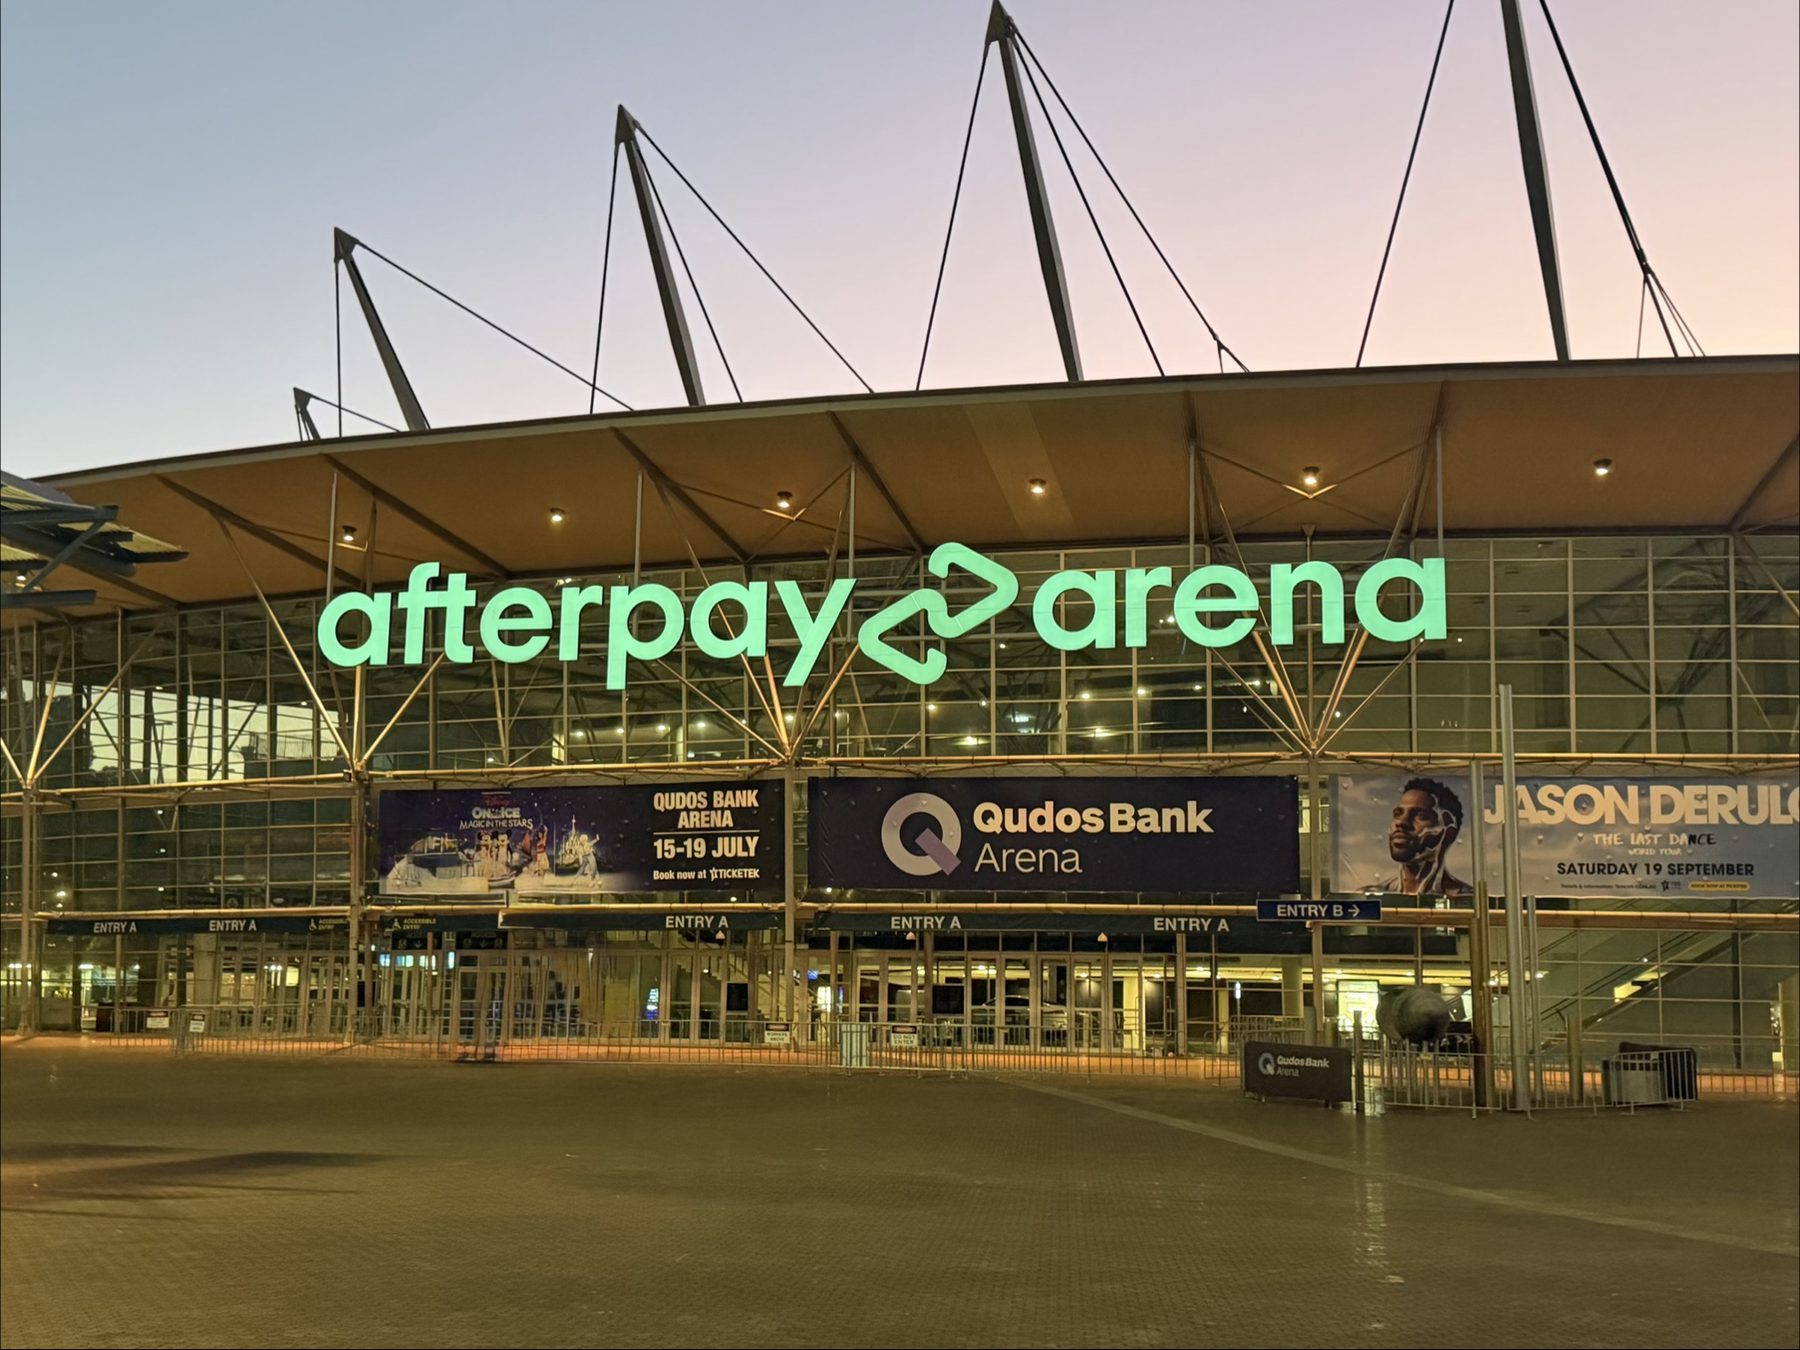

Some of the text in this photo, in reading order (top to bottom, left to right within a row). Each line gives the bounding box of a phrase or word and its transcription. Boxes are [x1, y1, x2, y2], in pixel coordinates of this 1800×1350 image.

[317, 557, 1448, 690] afterpay arena
[653, 789, 760, 812] QUDOS BANK
[1484, 784, 1640, 825] JASON
[501, 806, 521, 819] ICE
[973, 801, 1214, 835] Qudos Bank
[459, 820, 484, 830] MAGIC
[494, 819, 508, 827] THE
[508, 818, 534, 830] STARS
[678, 810, 734, 829] ARENA
[1593, 833, 1717, 845] THE LAST DANCE
[653, 836, 760, 859] 15-19 JULY
[1628, 848, 1682, 856] WORLD TOUR
[974, 843, 1082, 873] Arena
[653, 868, 760, 880] Book now at TICKETEK
[1557, 862, 1755, 876] SATURDAY 19 SEPTEMBER
[1277, 904, 1344, 917] ENTRY B
[93, 922, 137, 933] ENTRY A
[209, 920, 257, 931] ENTRY A
[665, 916, 729, 928] ENTRY A
[891, 916, 962, 929] ENTRY A
[1153, 917, 1230, 932] ENTRY A
[1276, 1055, 1330, 1068] Qudos Bank
[1276, 1066, 1299, 1077] Arena
